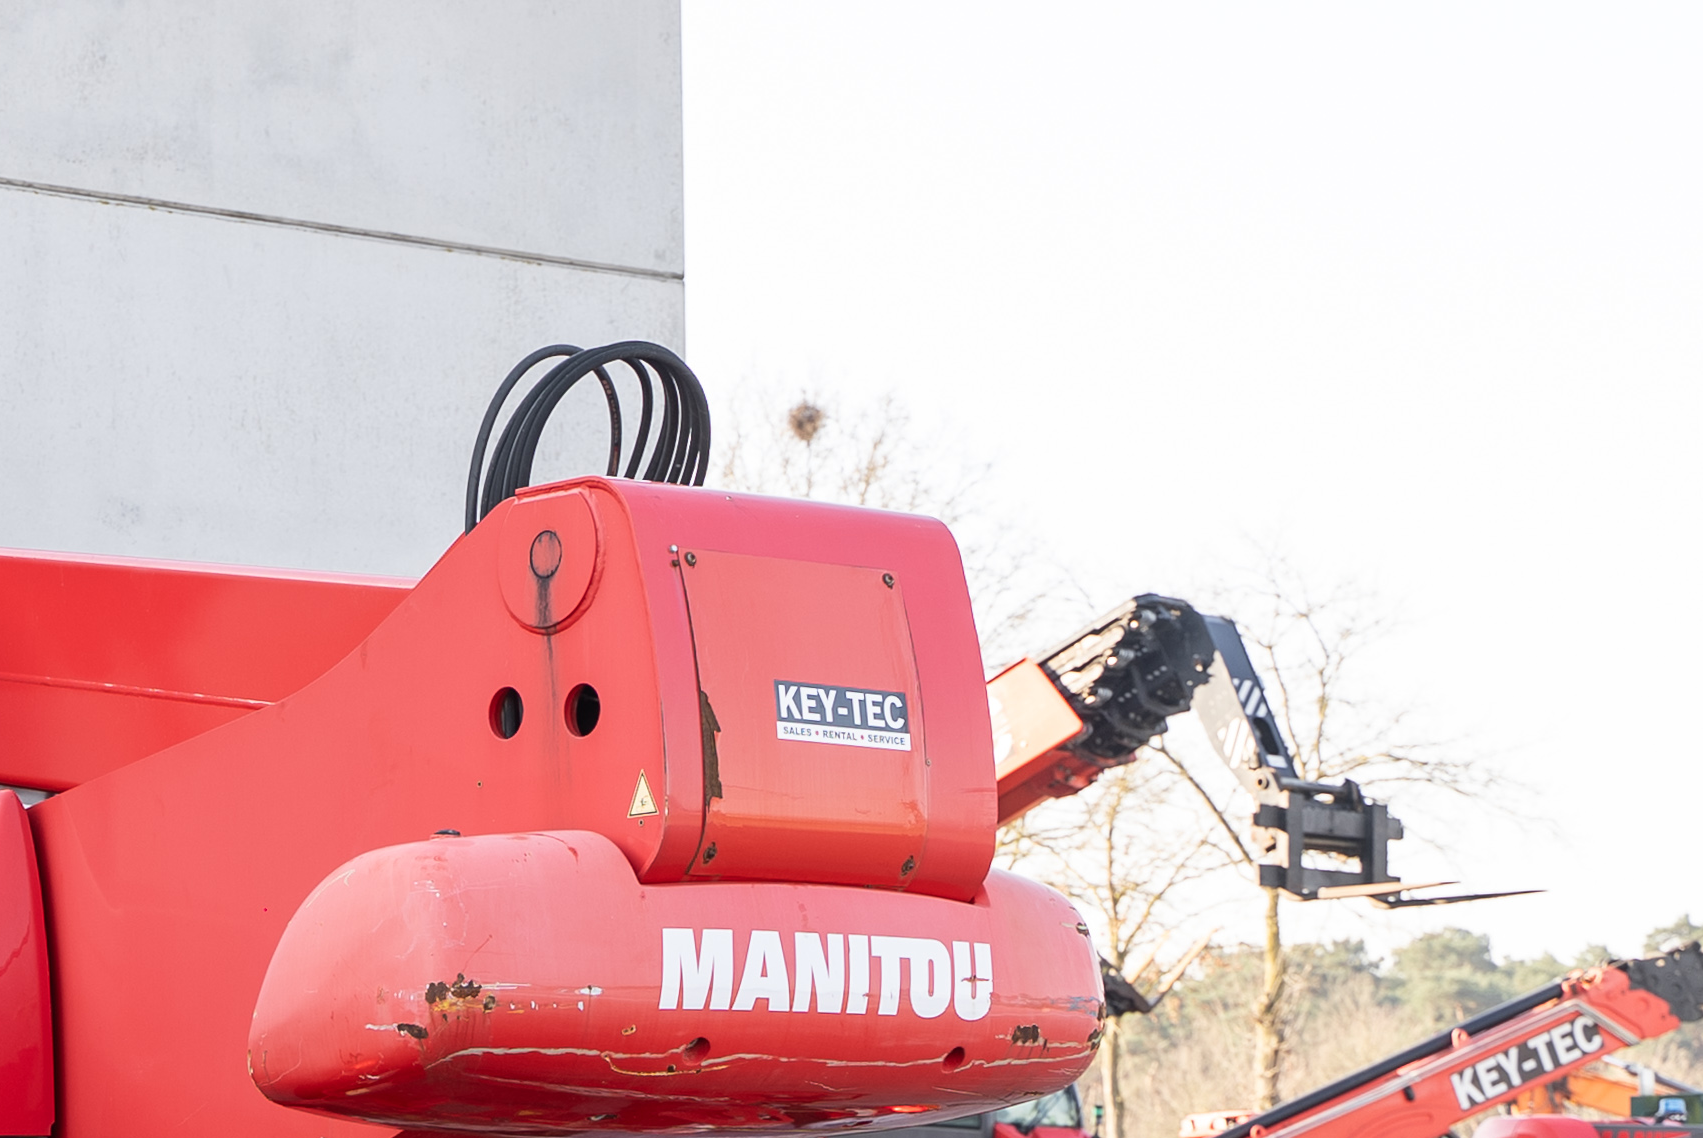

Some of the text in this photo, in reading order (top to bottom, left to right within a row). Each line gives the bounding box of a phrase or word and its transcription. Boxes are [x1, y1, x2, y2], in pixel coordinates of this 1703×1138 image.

[777, 684, 906, 730] KEY-TEC
[783, 726, 906, 746] SALES RENTAL SERVICE
[658, 928, 994, 1022] MANITOU
[1450, 1015, 1604, 1111] KEY-TEC
